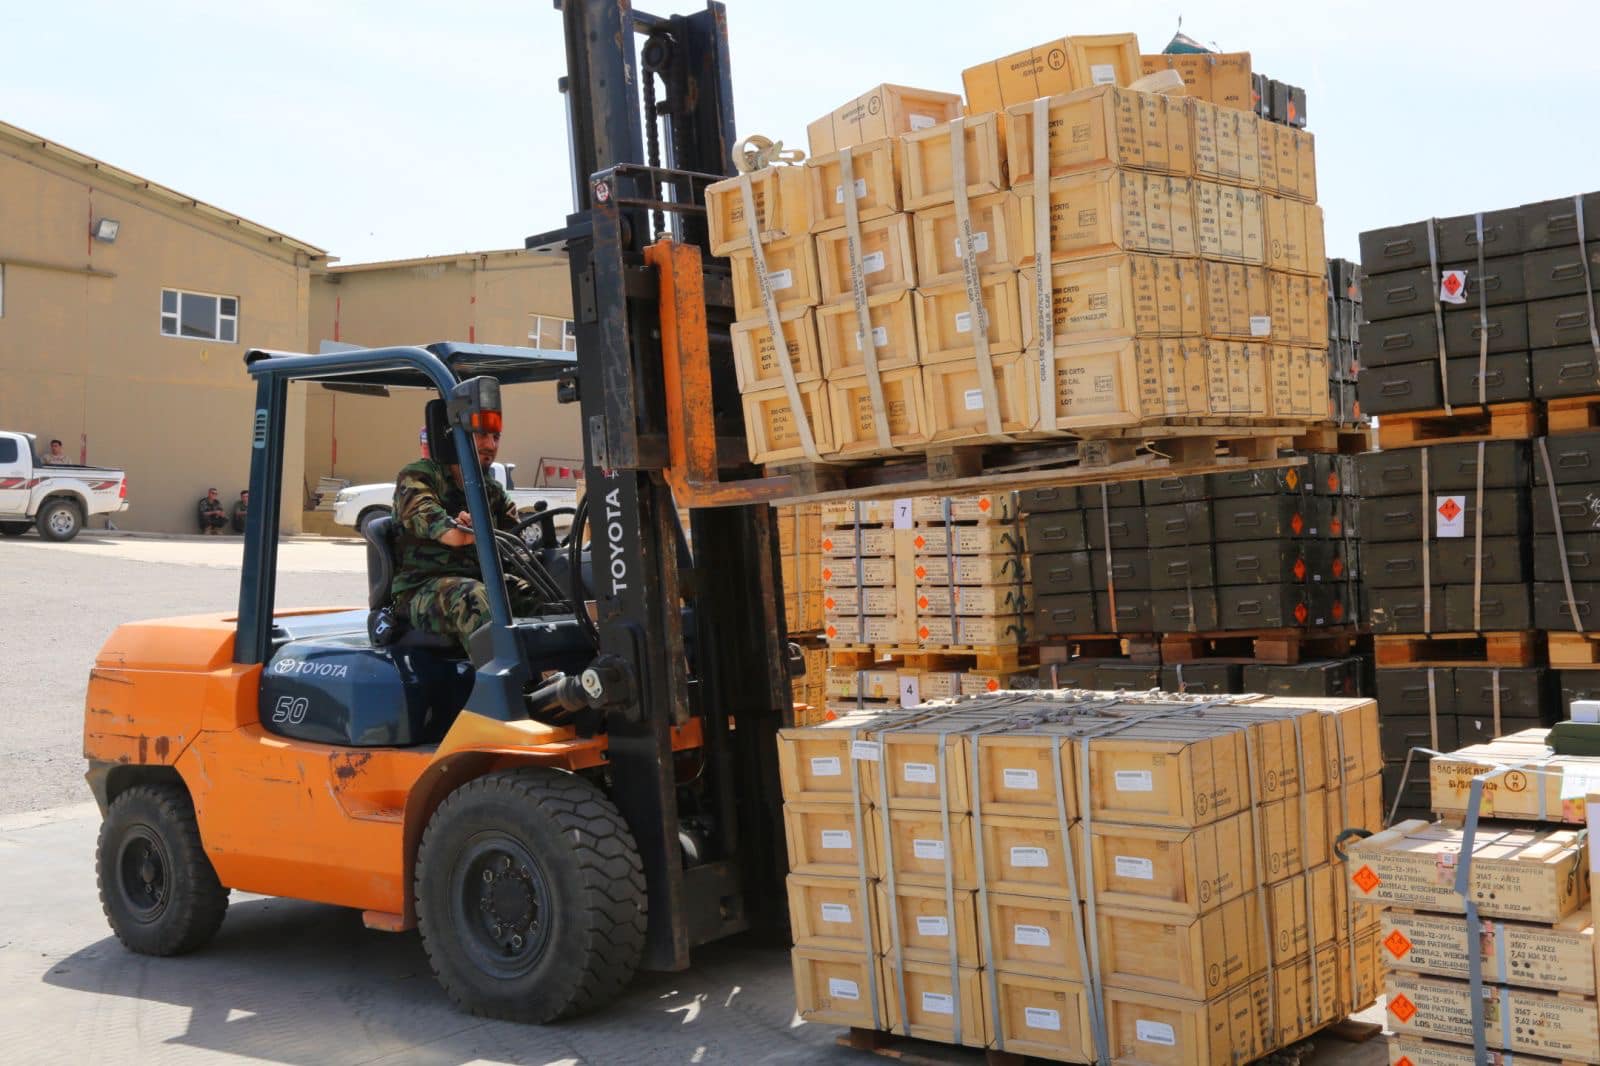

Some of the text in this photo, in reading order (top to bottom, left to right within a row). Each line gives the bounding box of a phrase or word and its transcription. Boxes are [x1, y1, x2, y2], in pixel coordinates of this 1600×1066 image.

[900, 506, 907, 517] 7
[605, 487, 628, 595] TOYOTA
[295, 661, 349, 678] TOYOTA
[906, 684, 913, 695] 4
[272, 696, 309, 724] 50
[1377, 890, 1393, 898] LOS
[1410, 956, 1425, 964] LOS
[1415, 1021, 1430, 1029] LOS
